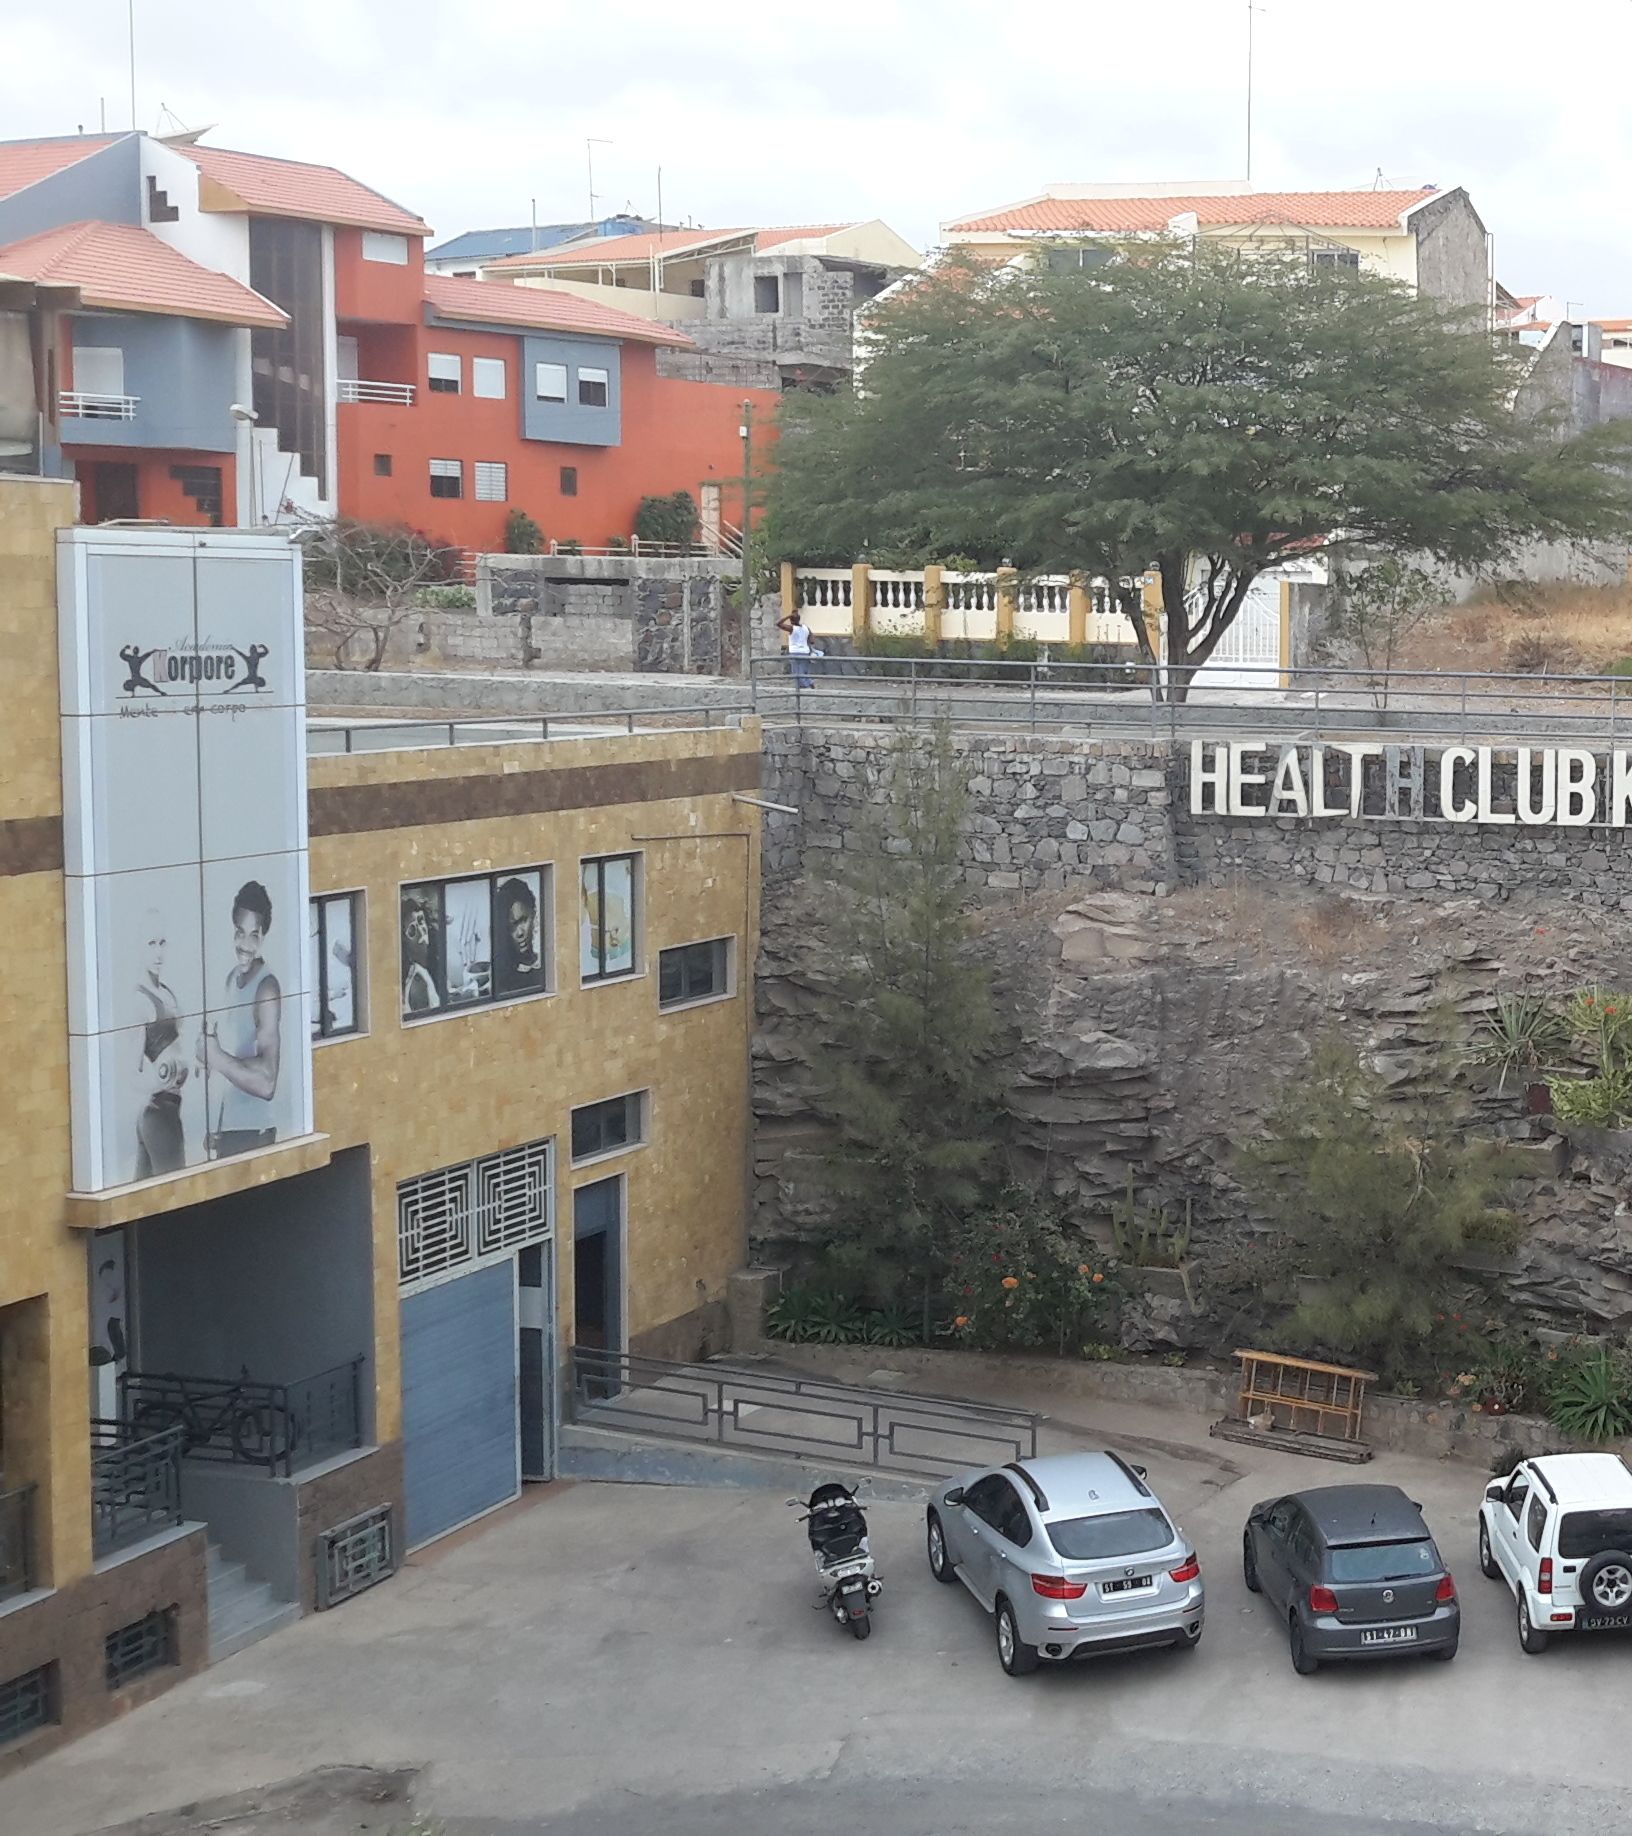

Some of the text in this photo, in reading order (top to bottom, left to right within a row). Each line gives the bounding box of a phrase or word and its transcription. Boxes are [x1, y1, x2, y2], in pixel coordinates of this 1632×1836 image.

[152, 650, 236, 684] Korpore
[1190, 739, 1425, 821] HEALTH
[1440, 746, 1597, 826] CLUB
